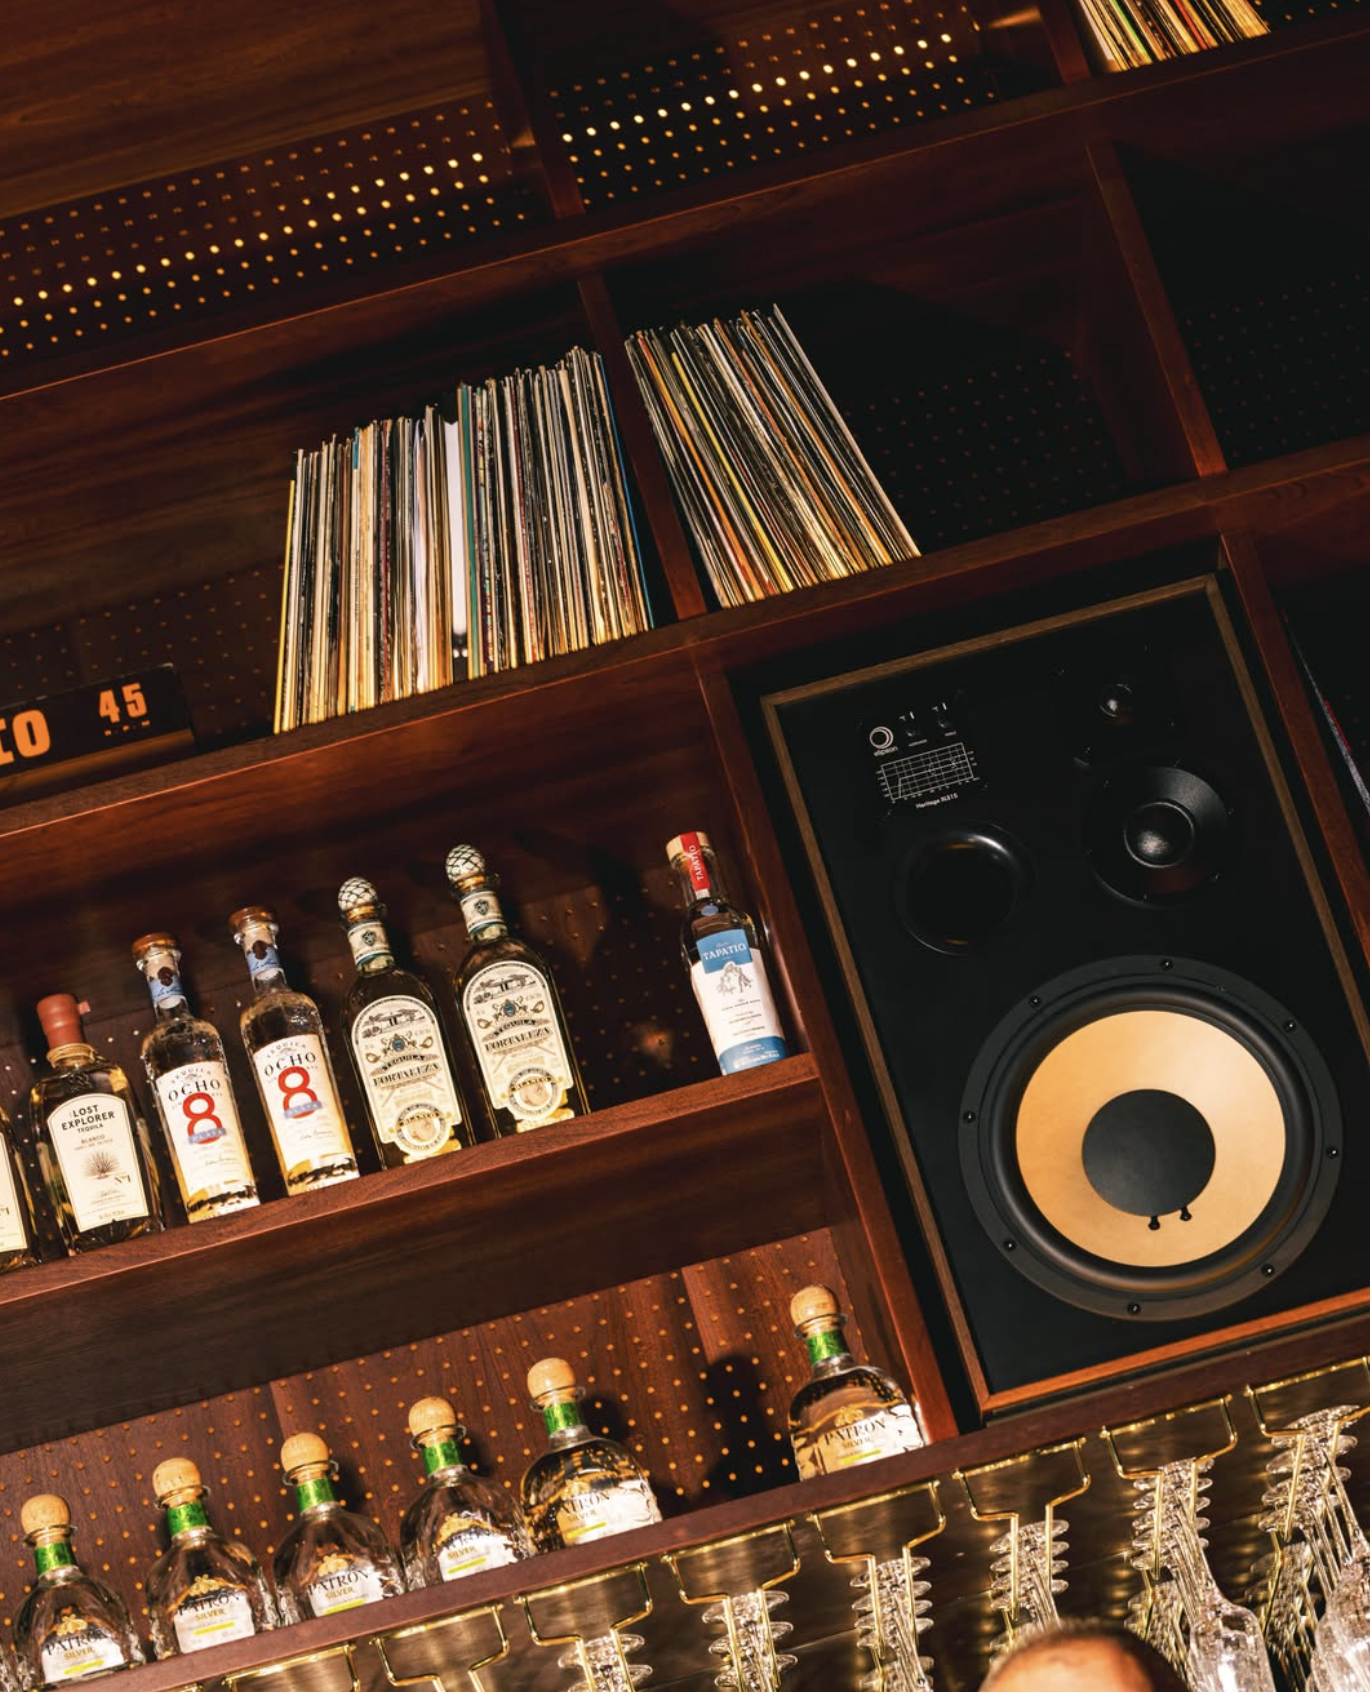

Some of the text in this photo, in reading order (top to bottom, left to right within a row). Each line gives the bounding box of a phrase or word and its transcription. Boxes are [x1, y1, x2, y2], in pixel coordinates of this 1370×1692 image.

[99, 682, 148, 724] 45
[702, 942, 747, 960] TAPATIO
[485, 1026, 552, 1052] FORTALEZA
[264, 1052, 316, 1076] OCHO
[373, 1062, 440, 1086] FORTALEZA
[168, 1079, 221, 1102] OCHO
[278, 1066, 318, 1119] 8
[61, 1111, 115, 1131] EXPLORER
[73, 1104, 99, 1118] LOST
[182, 1092, 223, 1145] 8
[77, 1123, 104, 1133] TEQUILA
[325, 1586, 355, 1600] SILVER
[195, 1608, 227, 1622] SILVER
[64, 1646, 96, 1660] SILVER
